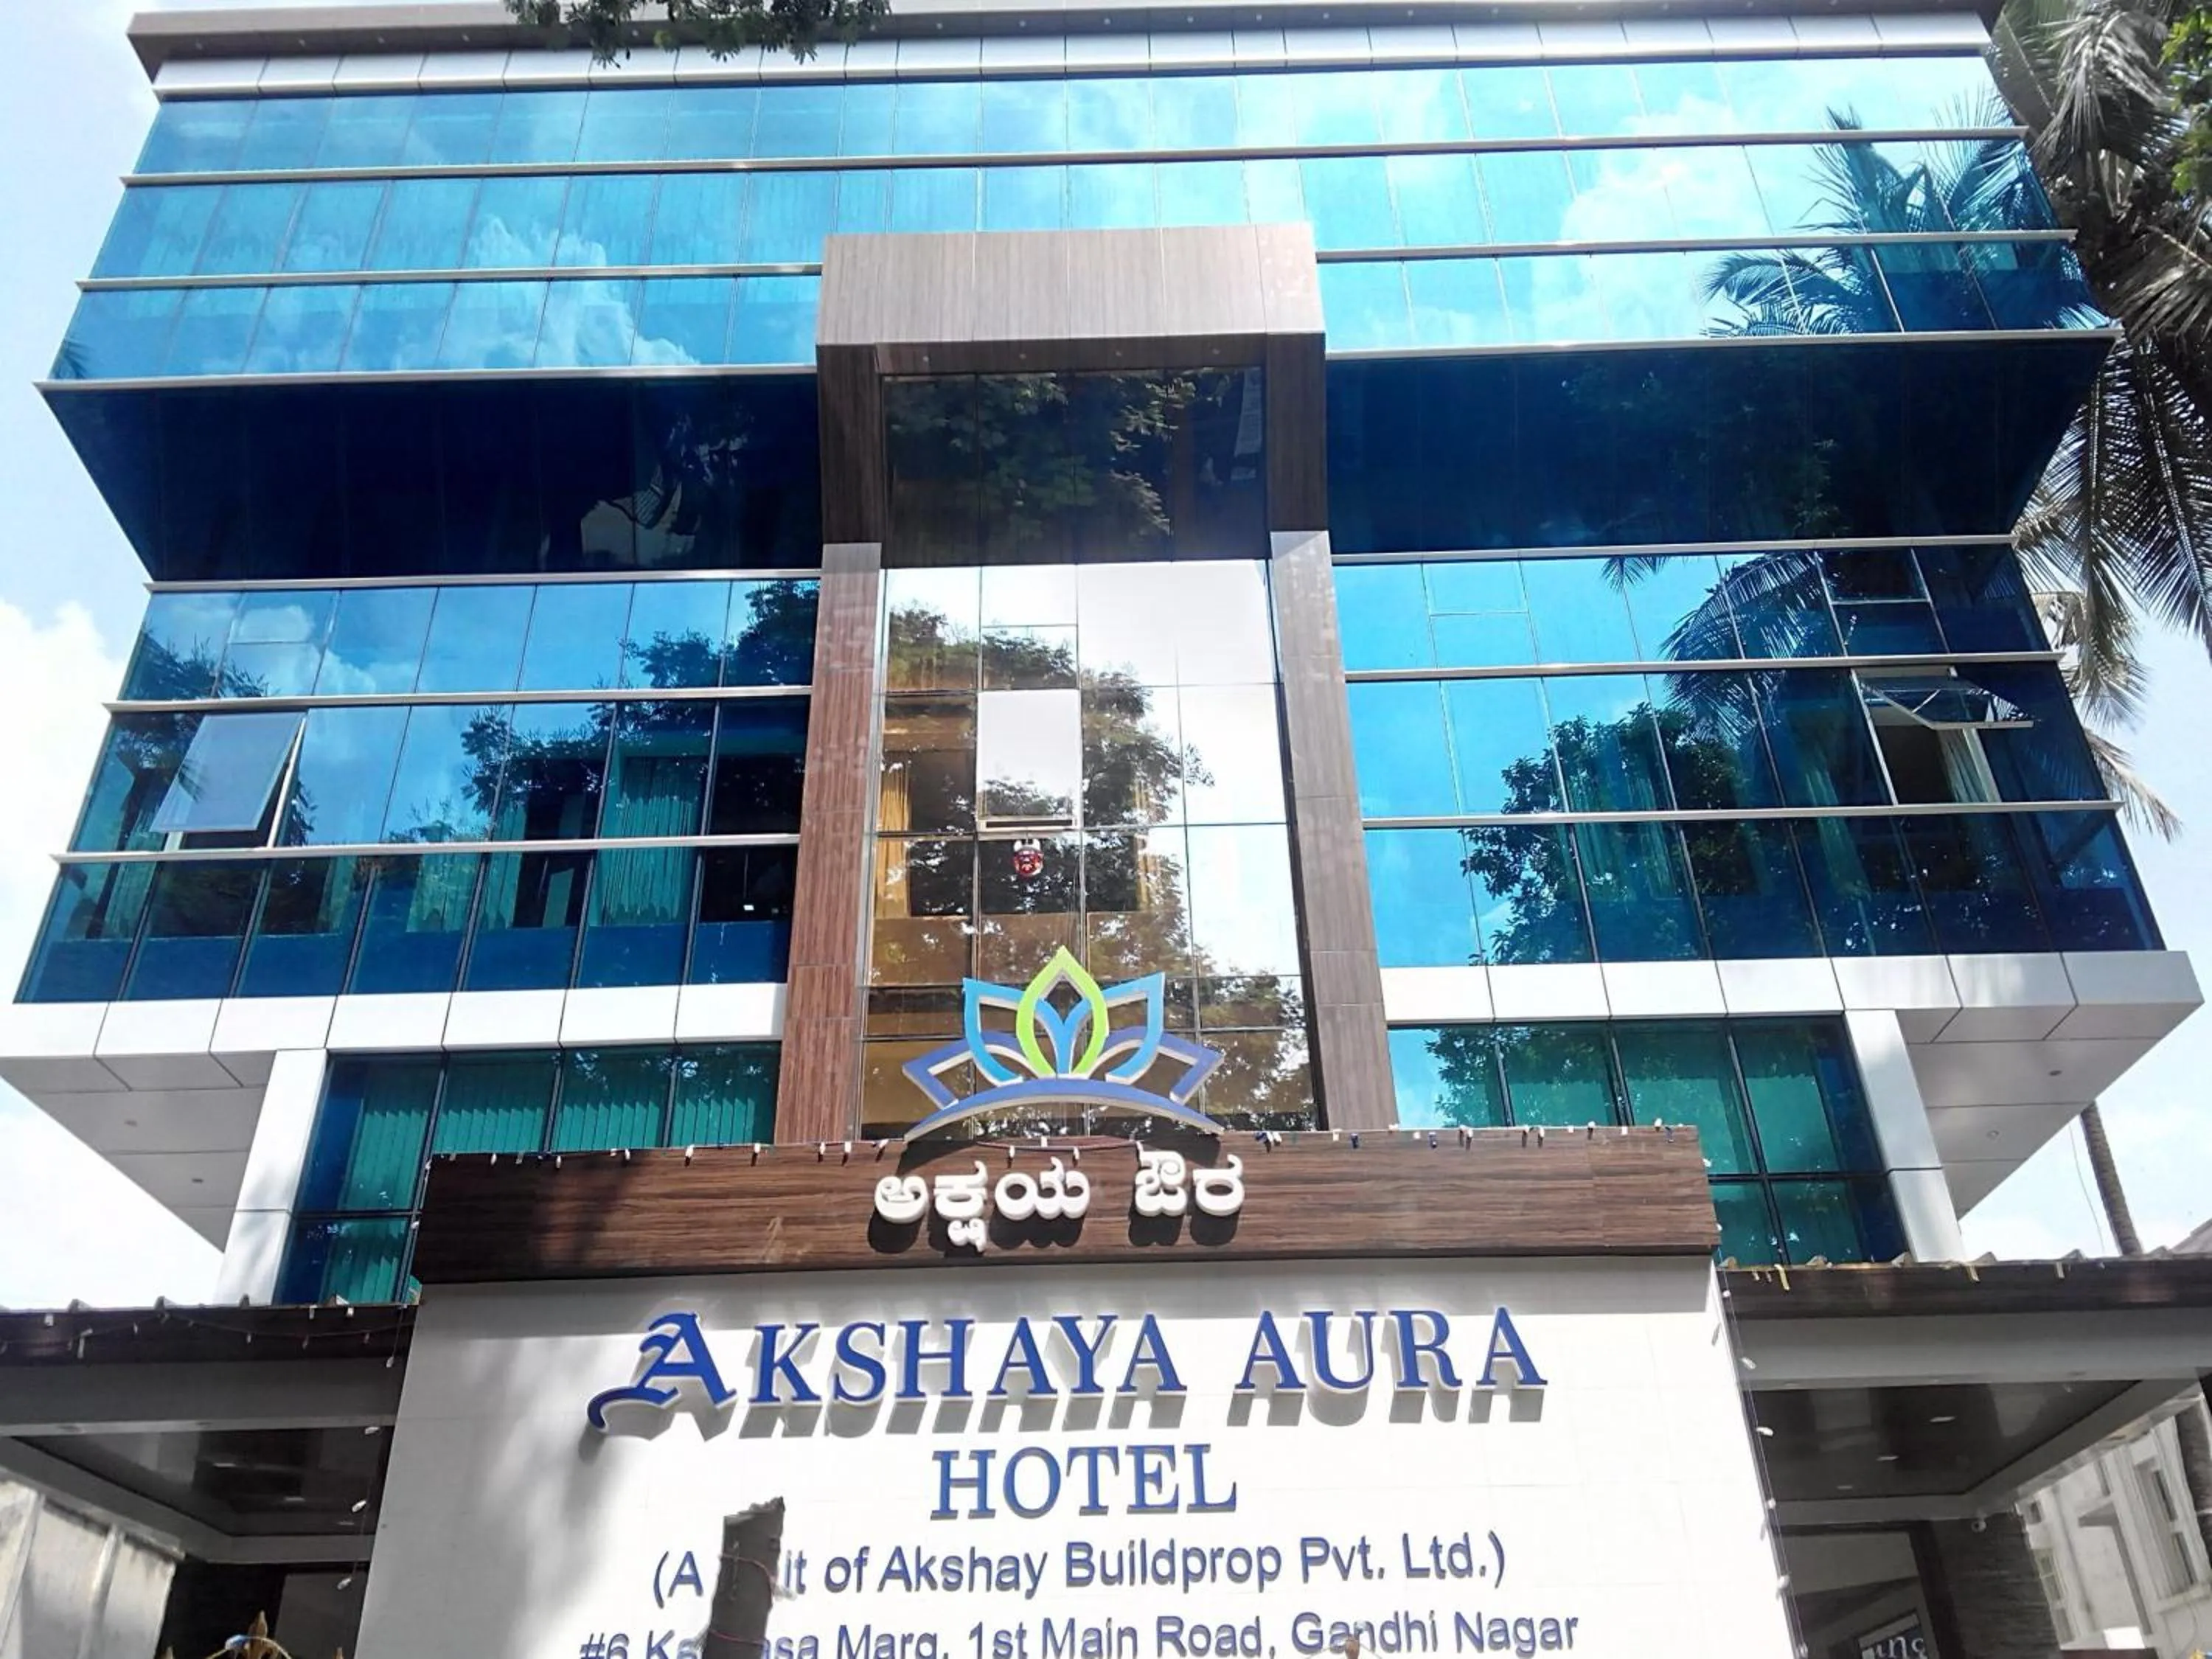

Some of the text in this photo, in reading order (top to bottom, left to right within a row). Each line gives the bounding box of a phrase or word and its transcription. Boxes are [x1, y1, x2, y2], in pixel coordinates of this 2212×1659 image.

[874, 1156, 1090, 1252] ಅಕ್ಷಯ
[588, 1307, 1548, 1430] AKSHAYA AURA
[931, 1443, 1237, 1520] HOTEL
[653, 1551, 704, 1609] (A
[824, 1546, 870, 1593] of
[877, 1545, 1048, 1599] Akshay
[1066, 1539, 1282, 1593] Buildprop
[1300, 1535, 1385, 1584] Pvt.
[1402, 1531, 1505, 1588] Ltd.)
[969, 1621, 1029, 1659] 1st
[1042, 1617, 1138, 1659] Main
[1156, 1615, 1276, 1659] Road,
[1291, 1610, 1438, 1655] Gandhi
[1454, 1610, 1579, 1659] Nagar
